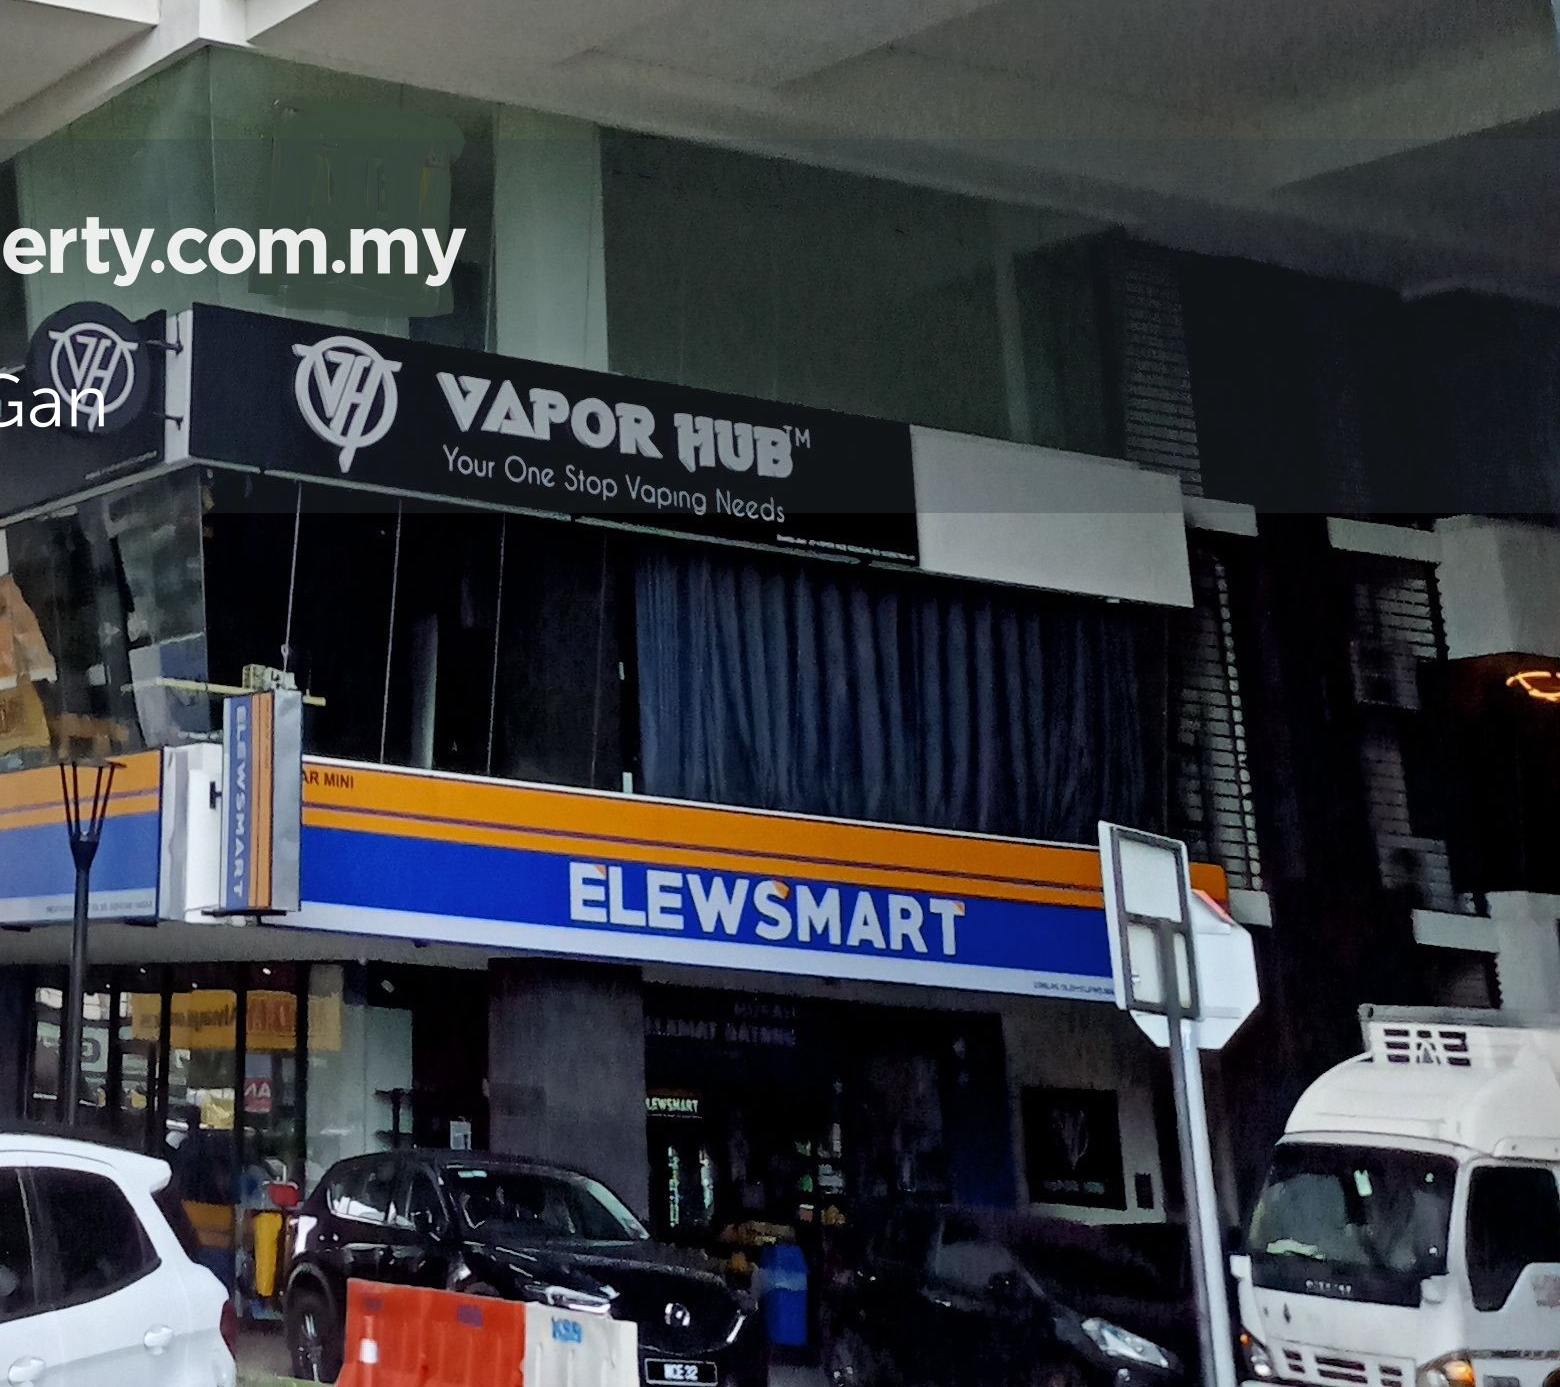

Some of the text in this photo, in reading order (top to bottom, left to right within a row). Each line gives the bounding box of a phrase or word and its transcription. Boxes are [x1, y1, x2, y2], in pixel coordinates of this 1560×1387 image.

[435, 370, 664, 460] VAPOR
[673, 412, 794, 479] HUB
[442, 443, 786, 524] Your One Stop Vaping Needs
[232, 704, 248, 897] ELEWSMART
[323, 772, 354, 789] MINI
[568, 860, 966, 956] ELEWSMART
[645, 1097, 699, 1113] LEWSMART
